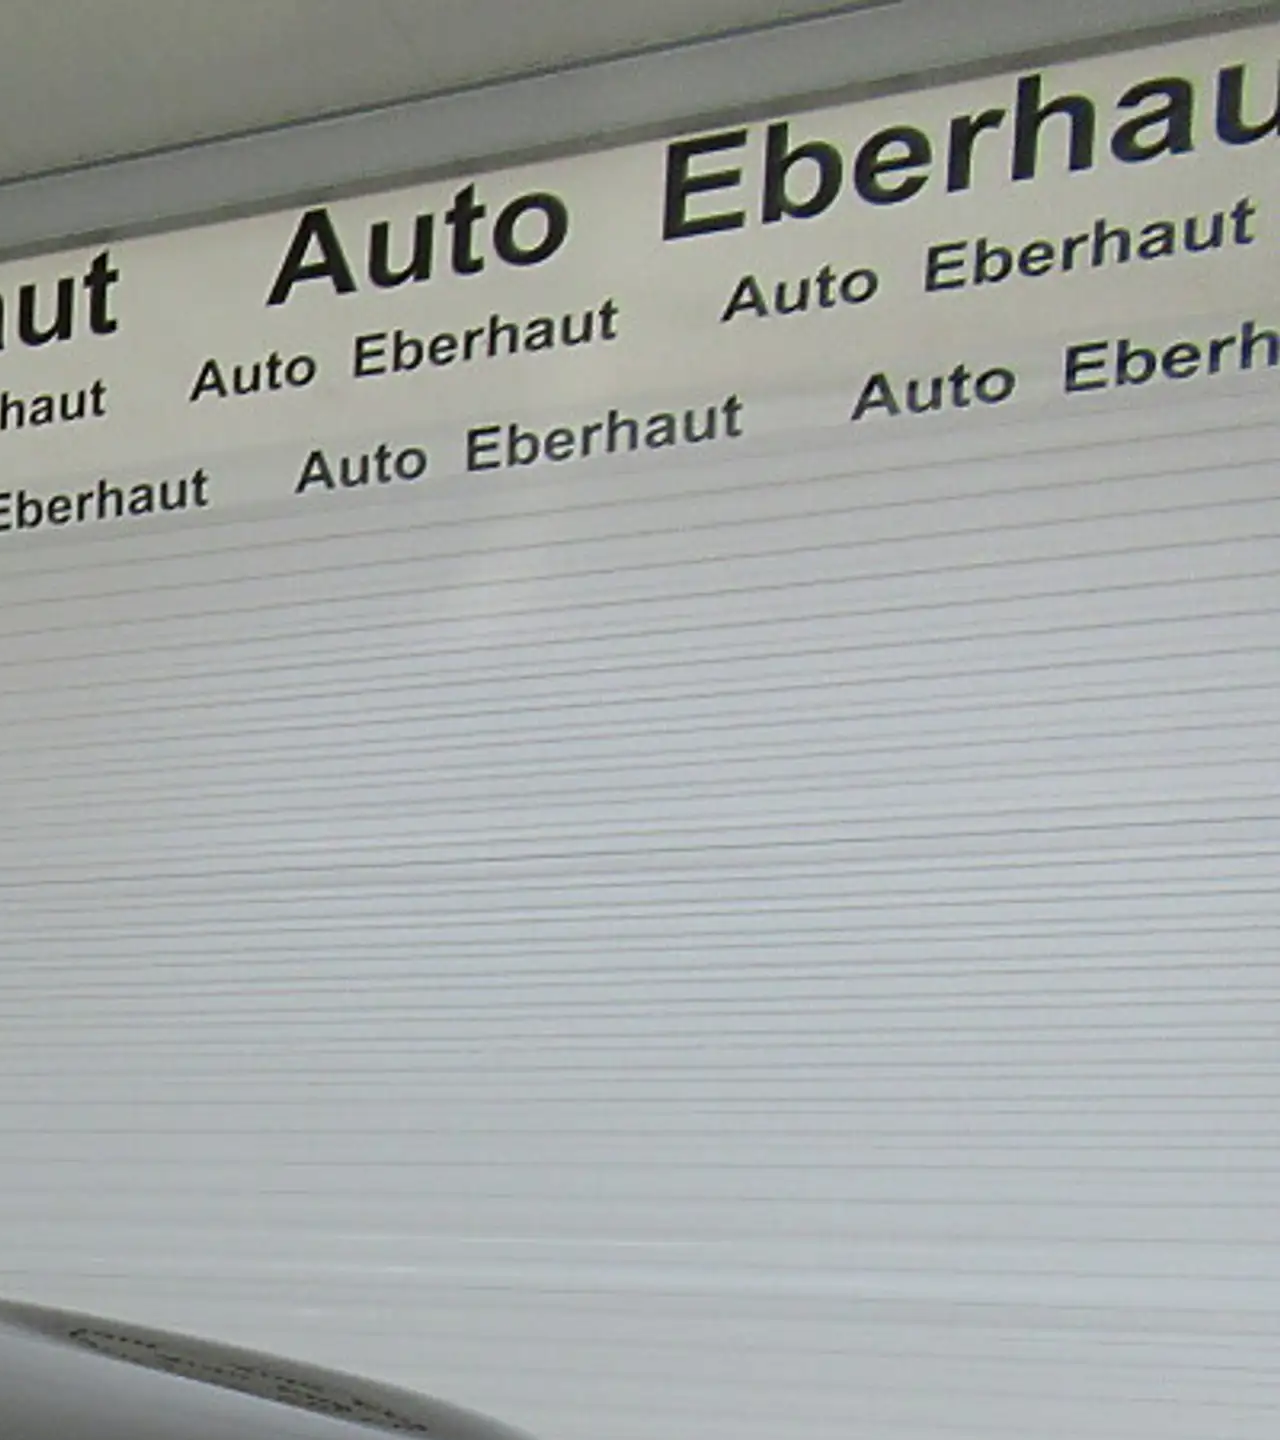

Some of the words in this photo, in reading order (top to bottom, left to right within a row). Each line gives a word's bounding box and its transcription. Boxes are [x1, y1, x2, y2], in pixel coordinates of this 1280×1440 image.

[265, 184, 569, 307] Auto
[662, 65, 1280, 242] Eberhau
[719, 264, 879, 323] Auto
[924, 197, 1257, 293] Eberhaut
[189, 350, 317, 403] Auto
[353, 298, 620, 379] Eberhaut
[850, 363, 1016, 422] Auto
[1064, 320, 1280, 395] Eberh
[294, 443, 428, 495] Auto
[466, 393, 744, 474] Eberhaut
